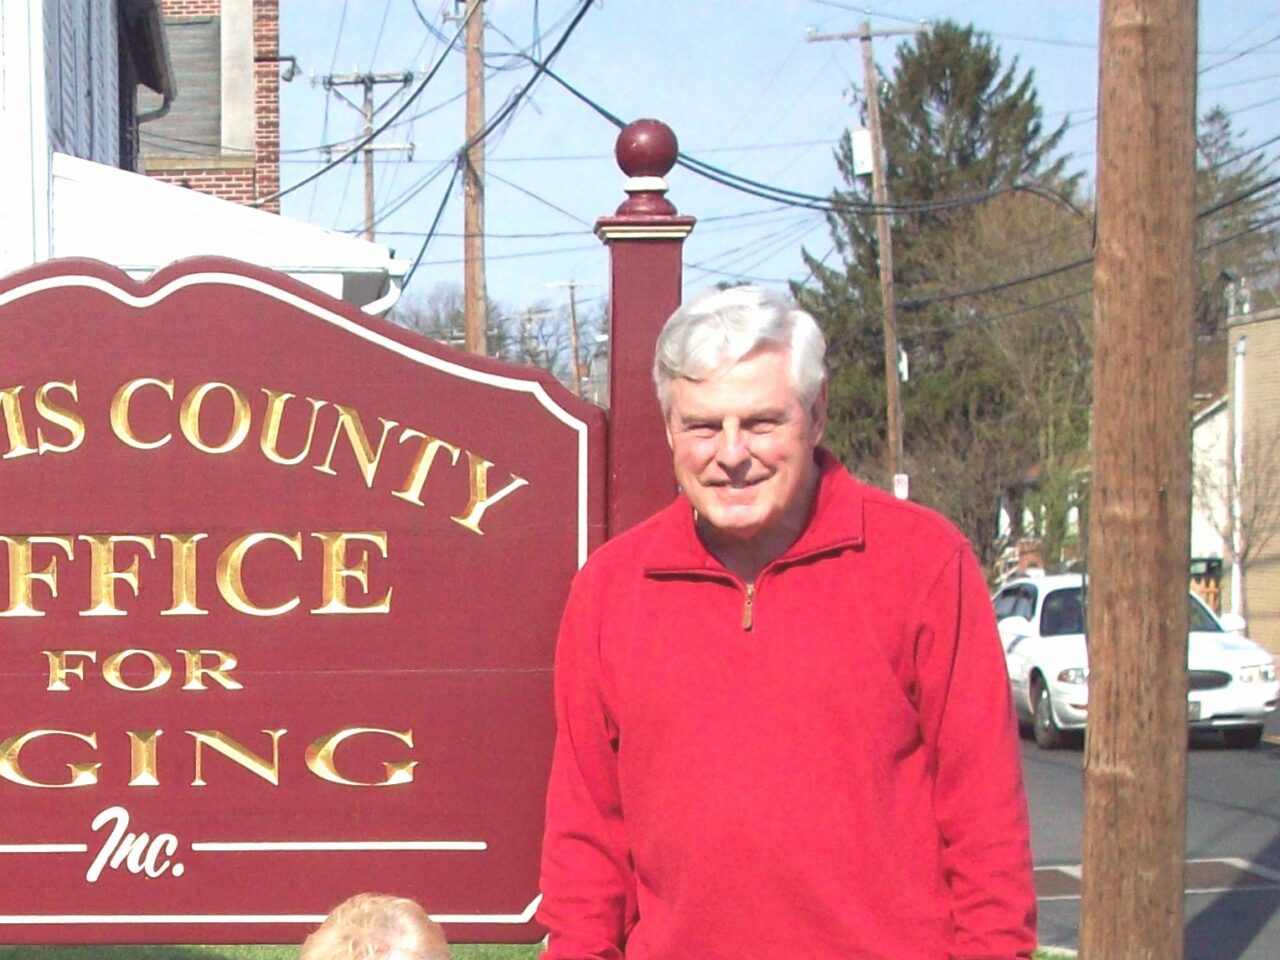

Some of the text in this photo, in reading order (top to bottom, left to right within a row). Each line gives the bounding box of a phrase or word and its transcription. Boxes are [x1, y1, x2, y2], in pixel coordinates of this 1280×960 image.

[109, 377, 529, 536] COUNTY
[41, 648, 244, 692] FOR
[86, 805, 185, 883] Inc.
